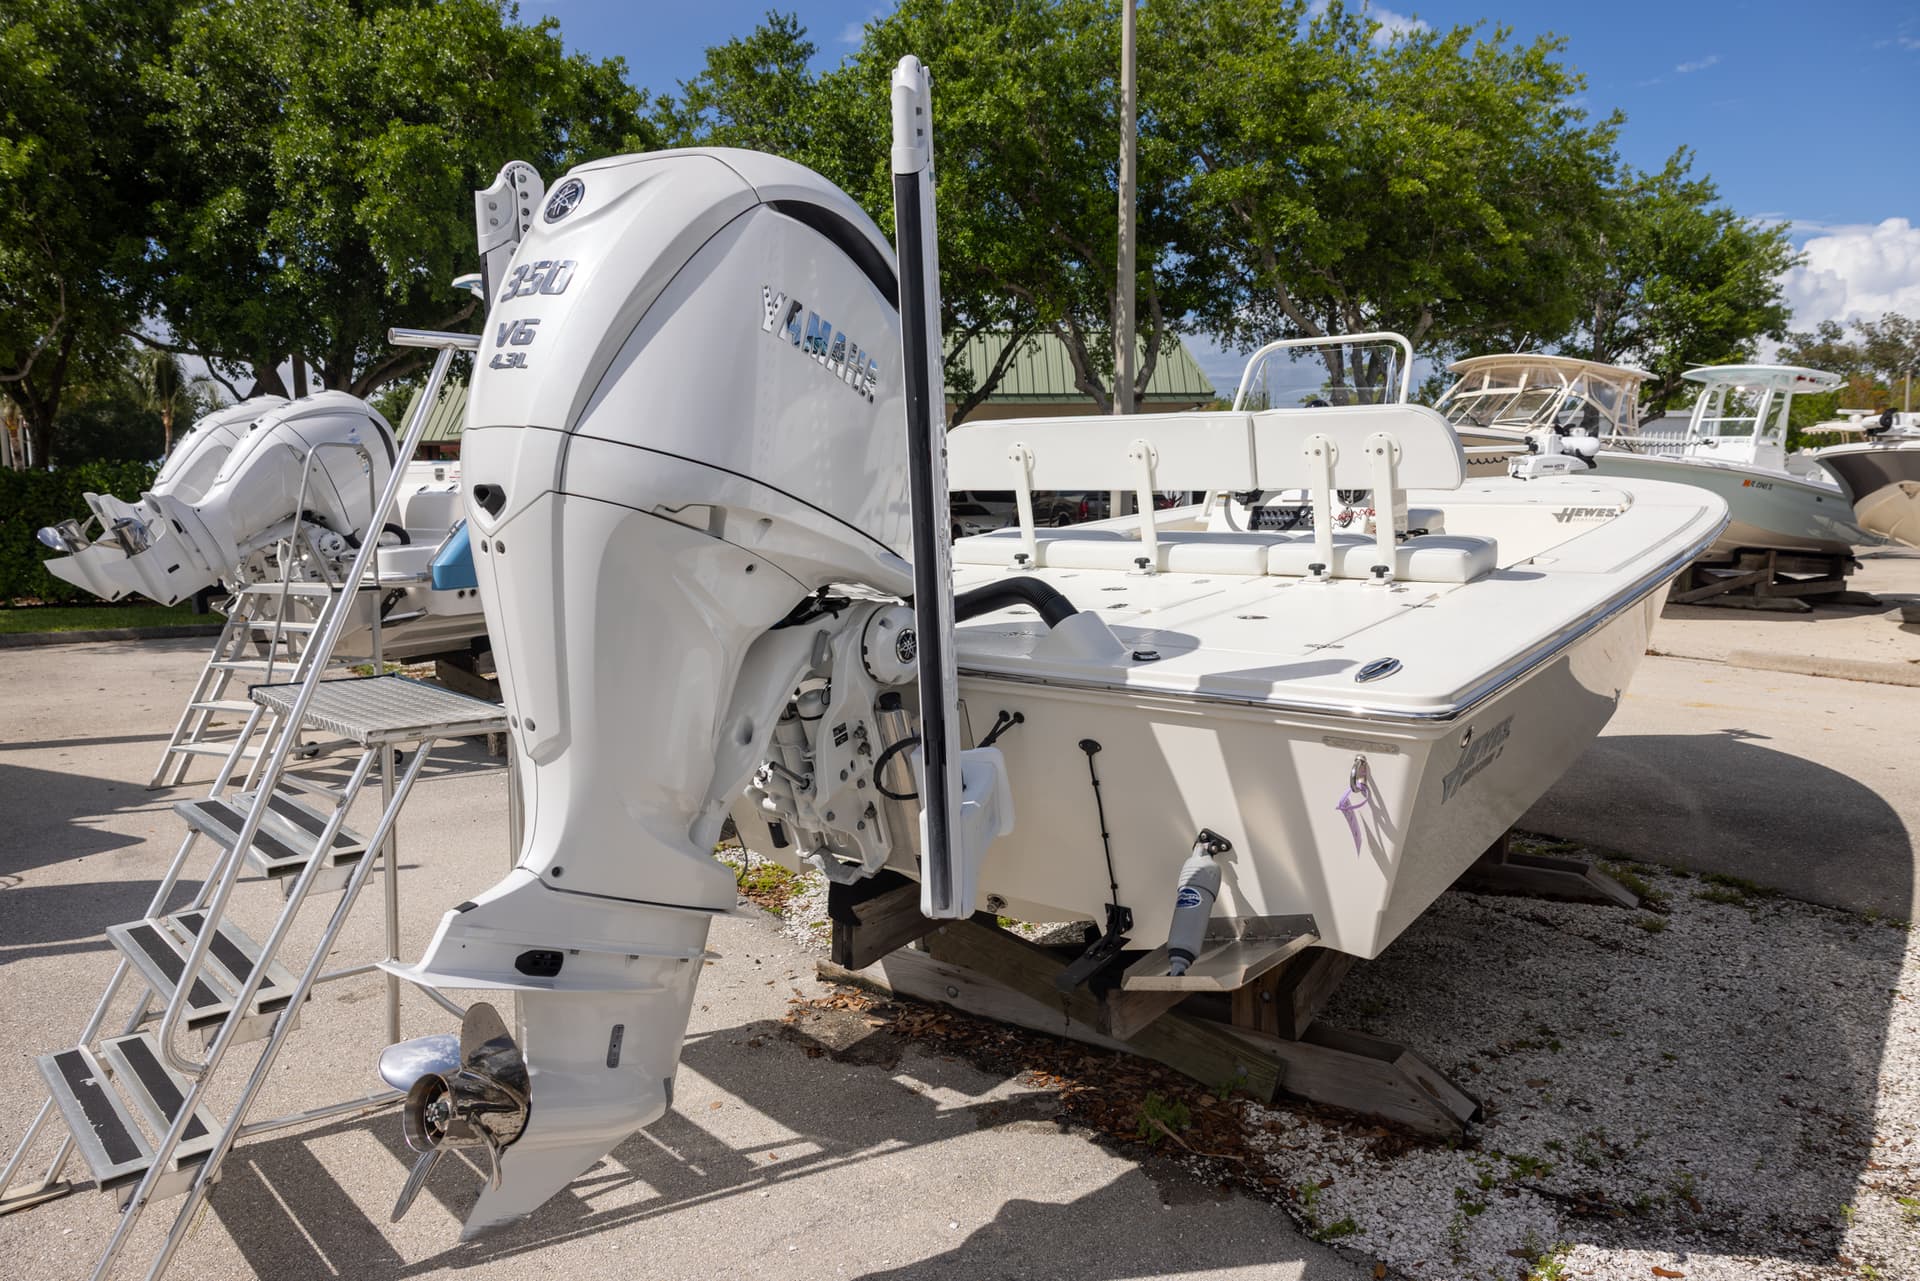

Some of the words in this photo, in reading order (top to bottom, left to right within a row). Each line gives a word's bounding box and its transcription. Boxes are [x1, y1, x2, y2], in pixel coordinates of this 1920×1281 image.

[500, 260, 578, 303] 350
[495, 318, 541, 348] V6
[761, 286, 879, 404] YAMAHA
